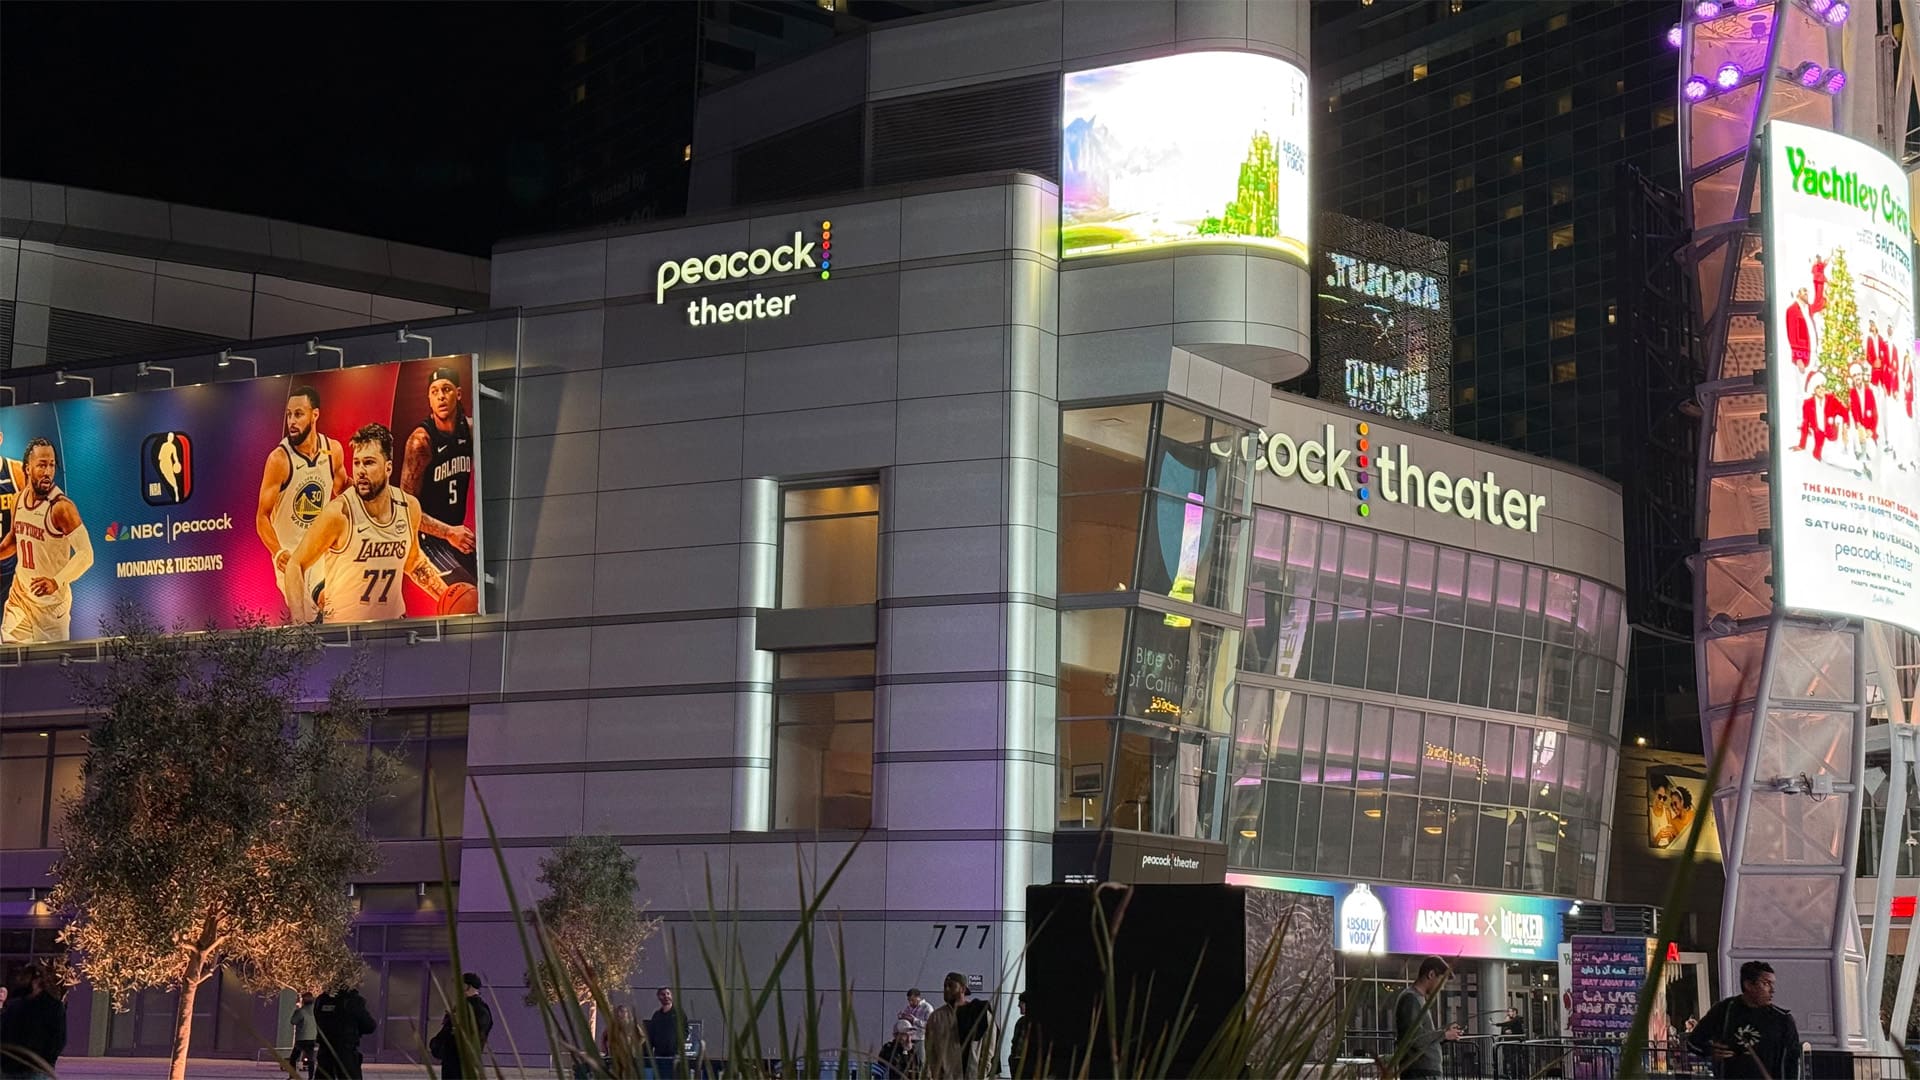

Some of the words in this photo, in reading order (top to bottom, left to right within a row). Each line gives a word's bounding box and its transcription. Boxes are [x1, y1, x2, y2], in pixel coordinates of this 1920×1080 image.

[657, 231, 816, 304] peacock
[687, 293, 796, 326] theater
[433, 455, 471, 482] ORLANDO
[149, 482, 162, 497] NBA
[310, 490, 322, 502] 30
[449, 480, 457, 504] 5
[1376, 444, 1546, 532] theater
[1803, 482, 1821, 493] THE
[1824, 486, 1864, 501] NATION'S
[131, 522, 164, 539] NBC
[172, 512, 233, 541] peacock
[1805, 517, 1868, 537] SATURDAY
[21, 539, 35, 570] 11
[353, 538, 407, 563] LAKERS
[1835, 543, 1882, 562] peacock
[117, 558, 165, 578] MONDAYS
[166, 557, 174, 574] &
[174, 554, 223, 573] TUESDAYS
[1837, 565, 1882, 579] DOWNTOWN
[359, 569, 396, 603] 77
[1136, 646, 1163, 668] Blue
[1142, 854, 1171, 869] peacock
[1173, 854, 1199, 870] theater
[932, 924, 991, 949] 777
